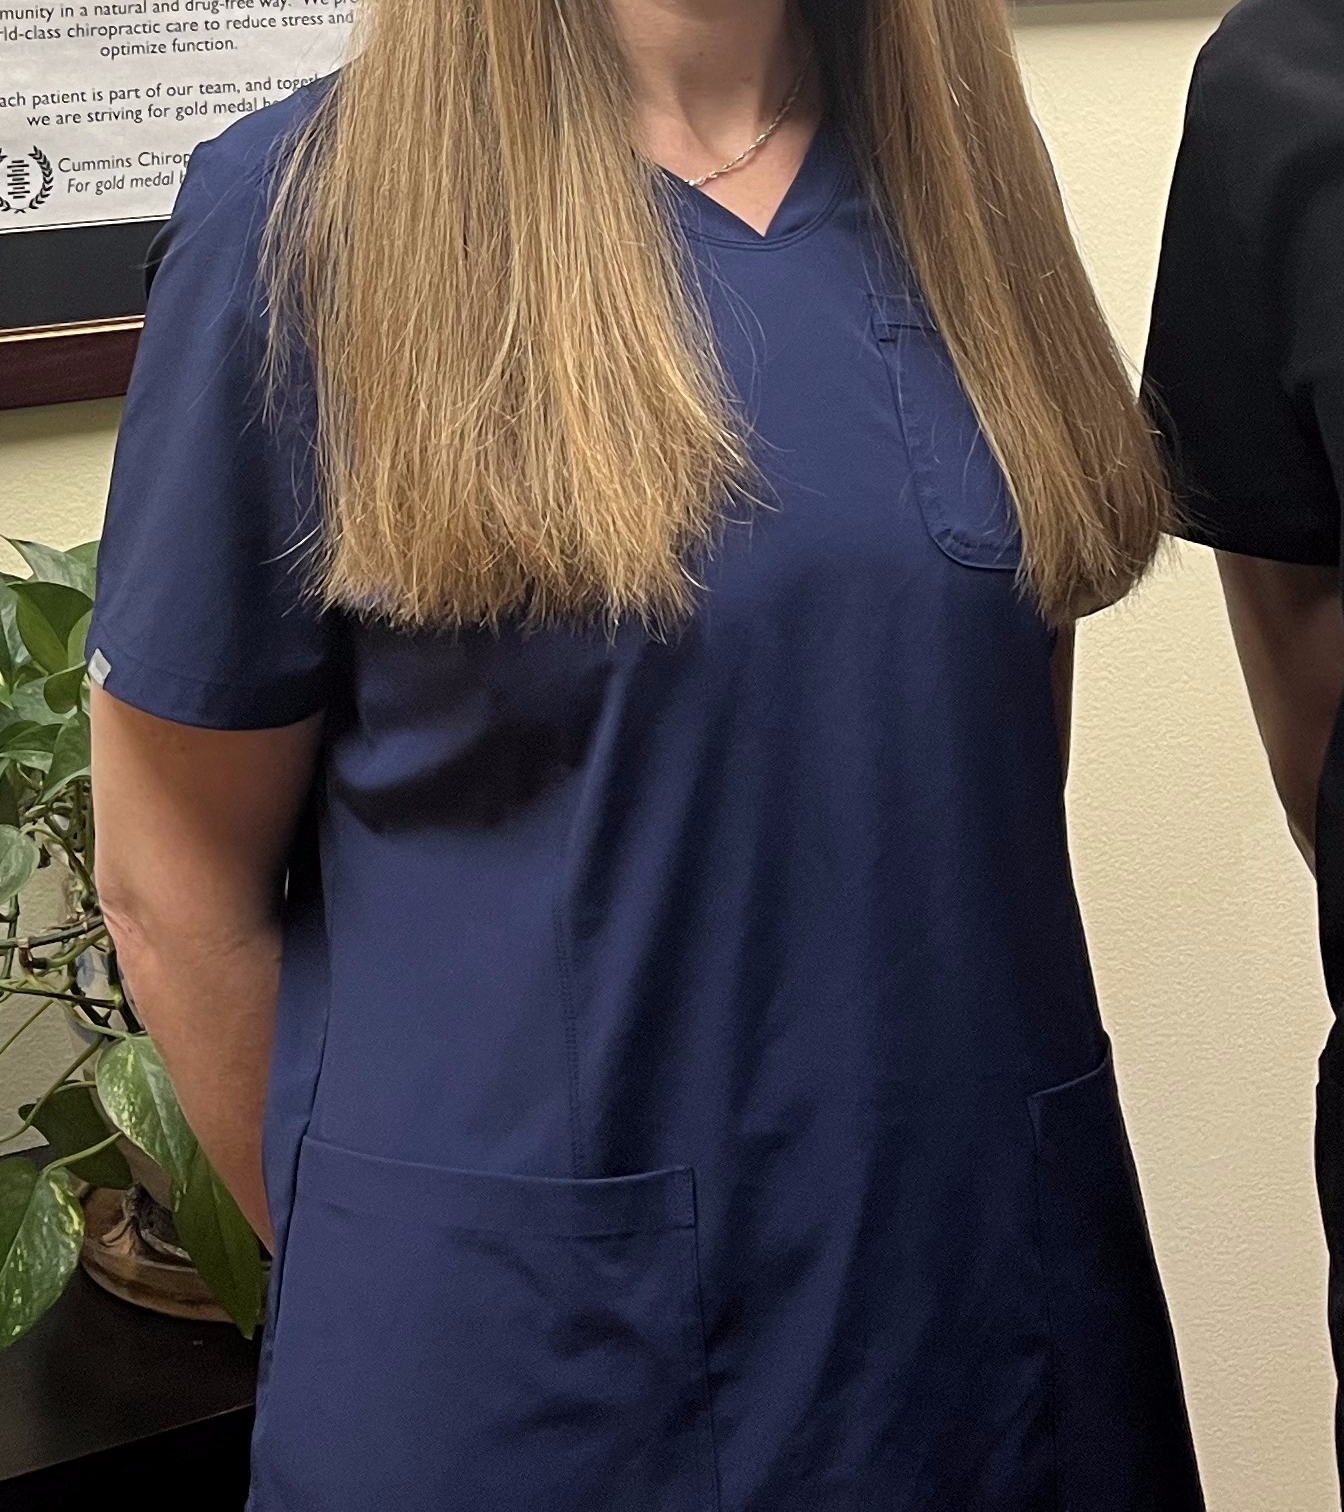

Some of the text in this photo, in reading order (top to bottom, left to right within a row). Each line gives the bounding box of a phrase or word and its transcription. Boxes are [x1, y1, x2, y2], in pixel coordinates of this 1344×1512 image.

[60, 3, 75, 18] in
[79, 6, 89, 17] a
[94, 0, 147, 16] natural
[100, 37, 238, 61] optimize function.
[32, 92, 88, 111] patient
[92, 88, 104, 102] is
[109, 88, 142, 106] part
[145, 83, 162, 99] of
[166, 85, 194, 97] our
[199, 83, 241, 96] team,
[245, 77, 272, 92] and
[58, 151, 192, 174] Cummins Chirop
[67, 178, 91, 194] For
[95, 174, 126, 196] gold
[130, 170, 175, 189] medal
